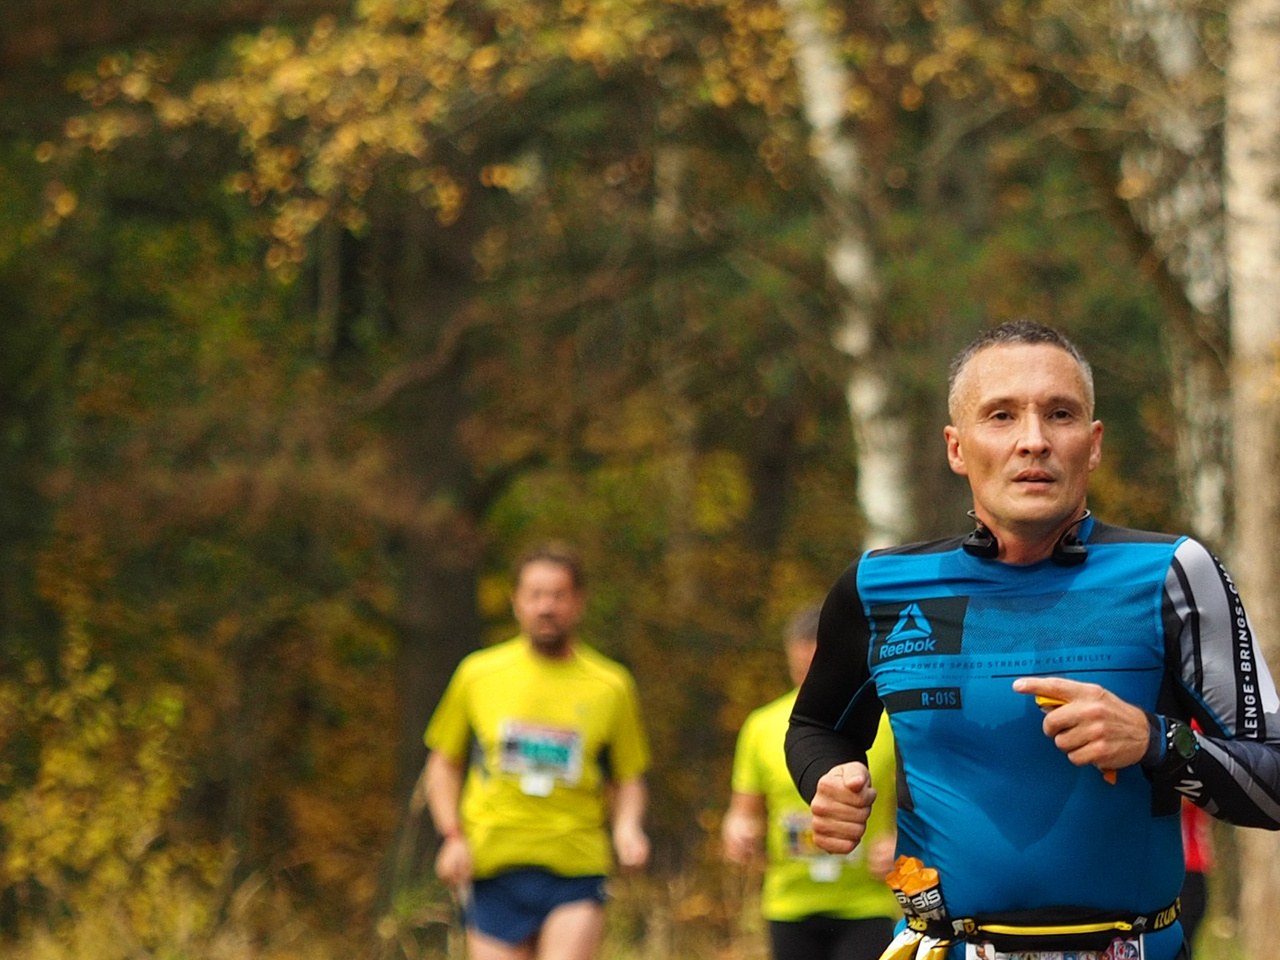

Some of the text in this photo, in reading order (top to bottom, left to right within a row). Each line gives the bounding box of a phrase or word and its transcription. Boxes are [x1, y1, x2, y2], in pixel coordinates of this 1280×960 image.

[879, 636, 937, 660] Reebok
[1235, 605, 1252, 672] BRINGS
[910, 654, 1112, 671] POWER SPEED STRENGTH FLEXIBILITY
[921, 691, 957, 707] R-01S
